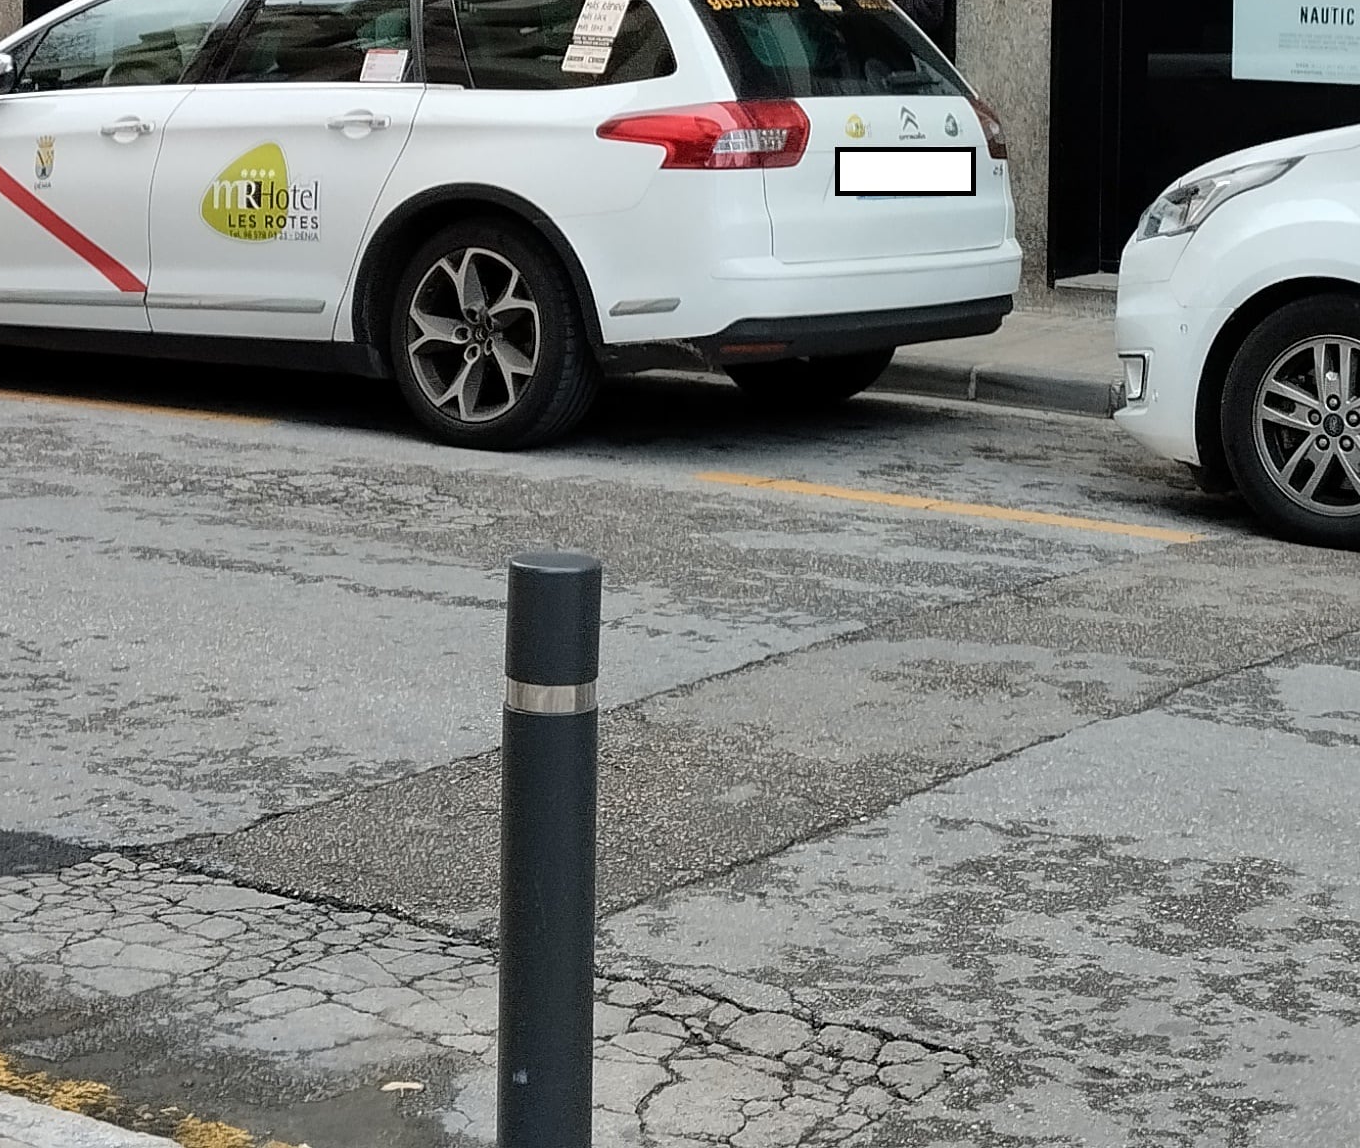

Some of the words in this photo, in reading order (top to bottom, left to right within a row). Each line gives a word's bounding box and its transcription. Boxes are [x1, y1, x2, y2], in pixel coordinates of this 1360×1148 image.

[1300, 6, 1355, 26] NAUTIC
[228, 214, 256, 228] LES
[264, 215, 319, 229] ROTES
